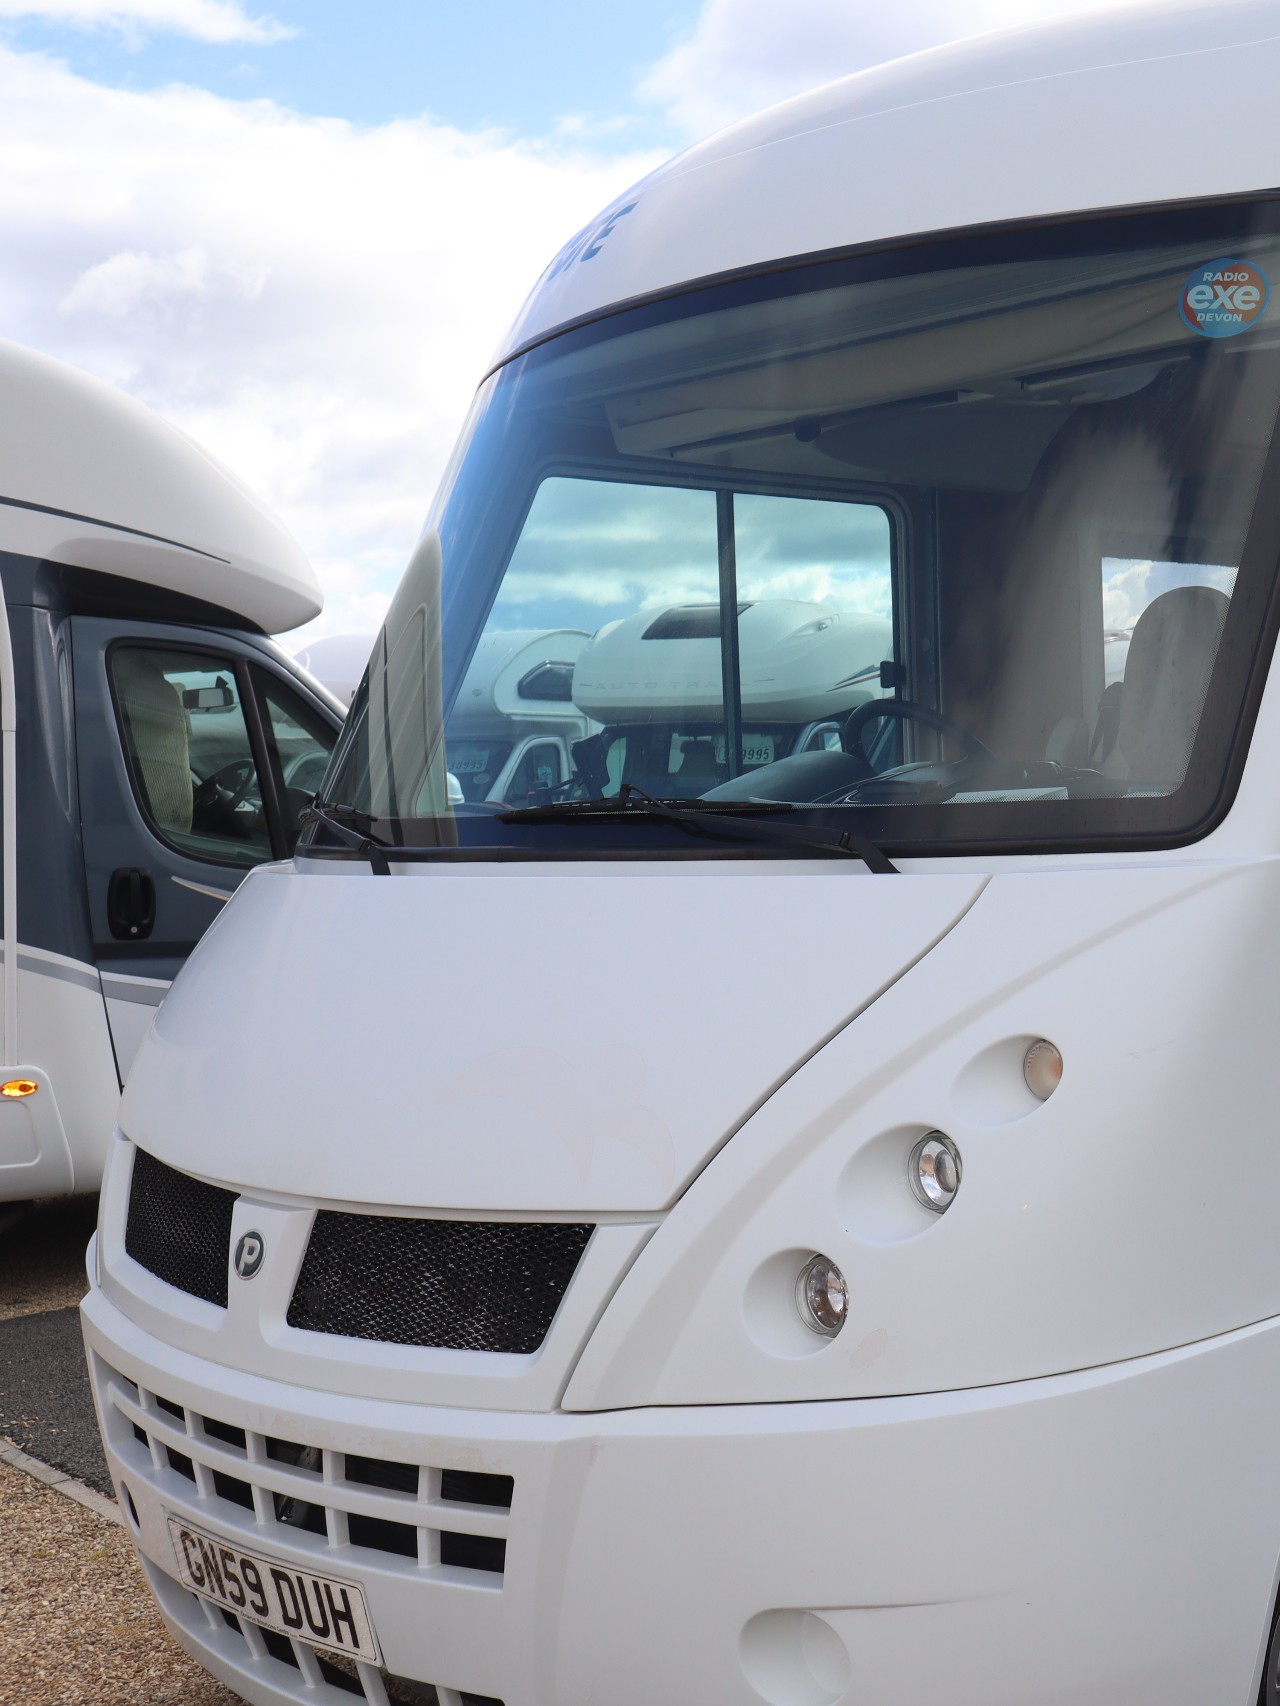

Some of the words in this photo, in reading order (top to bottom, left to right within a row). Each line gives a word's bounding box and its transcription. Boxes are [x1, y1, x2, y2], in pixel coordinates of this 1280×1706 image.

[1202, 271, 1249, 282] RADIO
[1186, 284, 1260, 311] exe
[1196, 312, 1242, 322] DEVON
[180, 1528, 269, 1618] GN59
[269, 1567, 361, 1650] DUH
